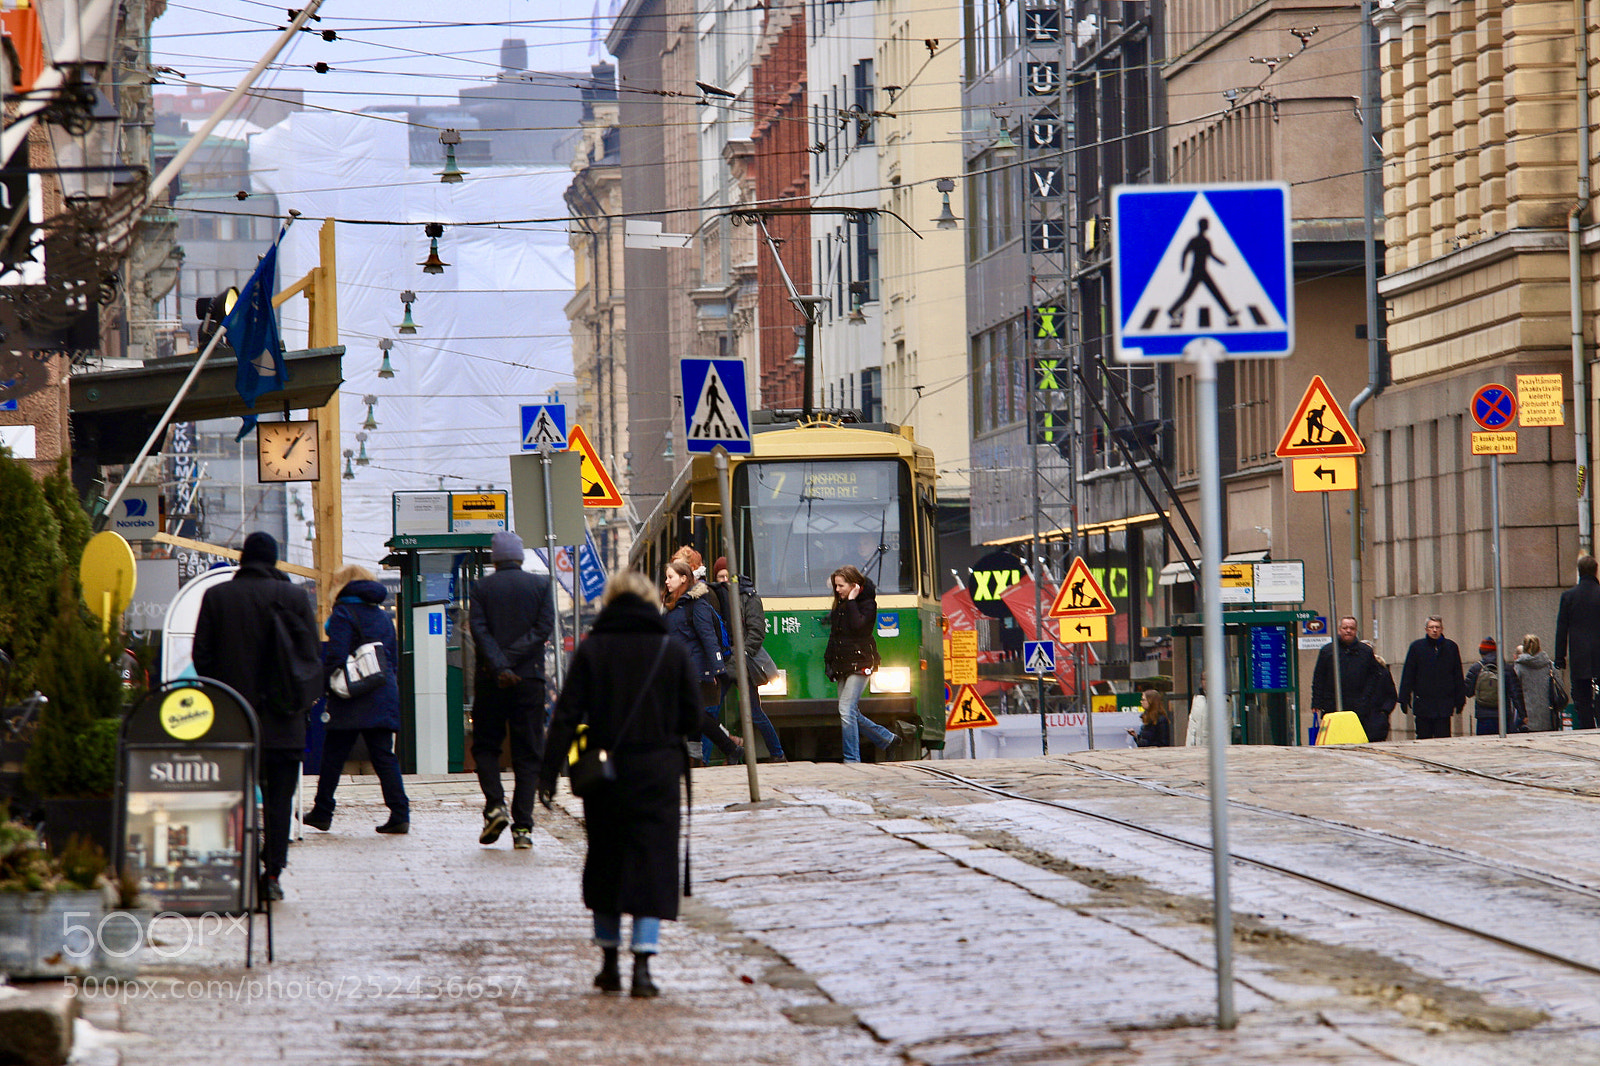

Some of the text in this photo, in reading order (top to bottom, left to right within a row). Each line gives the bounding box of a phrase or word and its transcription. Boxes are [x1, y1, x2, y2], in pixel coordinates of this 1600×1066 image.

[769, 471, 786, 499] 7
[116, 520, 155, 528] Nordea
[781, 616, 800, 626] HSL
[781, 624, 801, 634] HRT
[150, 761, 220, 782] sunn
